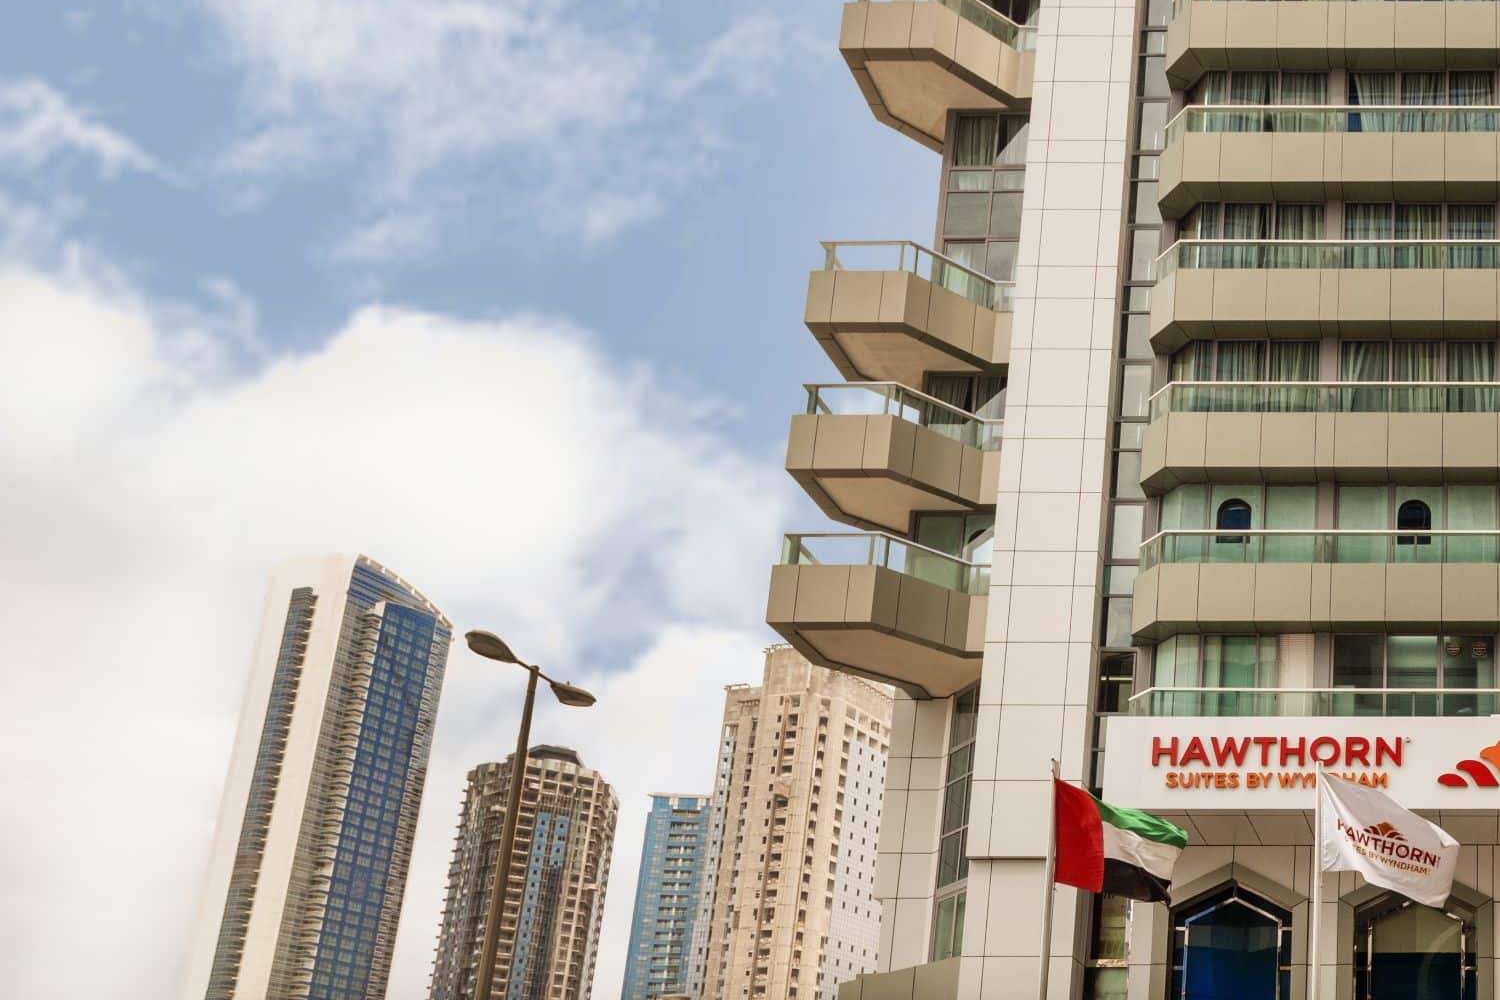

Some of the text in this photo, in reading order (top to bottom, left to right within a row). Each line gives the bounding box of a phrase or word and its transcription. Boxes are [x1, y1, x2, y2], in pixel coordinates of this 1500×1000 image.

[1151, 736, 1403, 767] HAWTHORN
[1165, 772, 1240, 789] SUITES
[1246, 772, 1273, 789] BY
[1380, 856, 1428, 875] WYNDHAM
